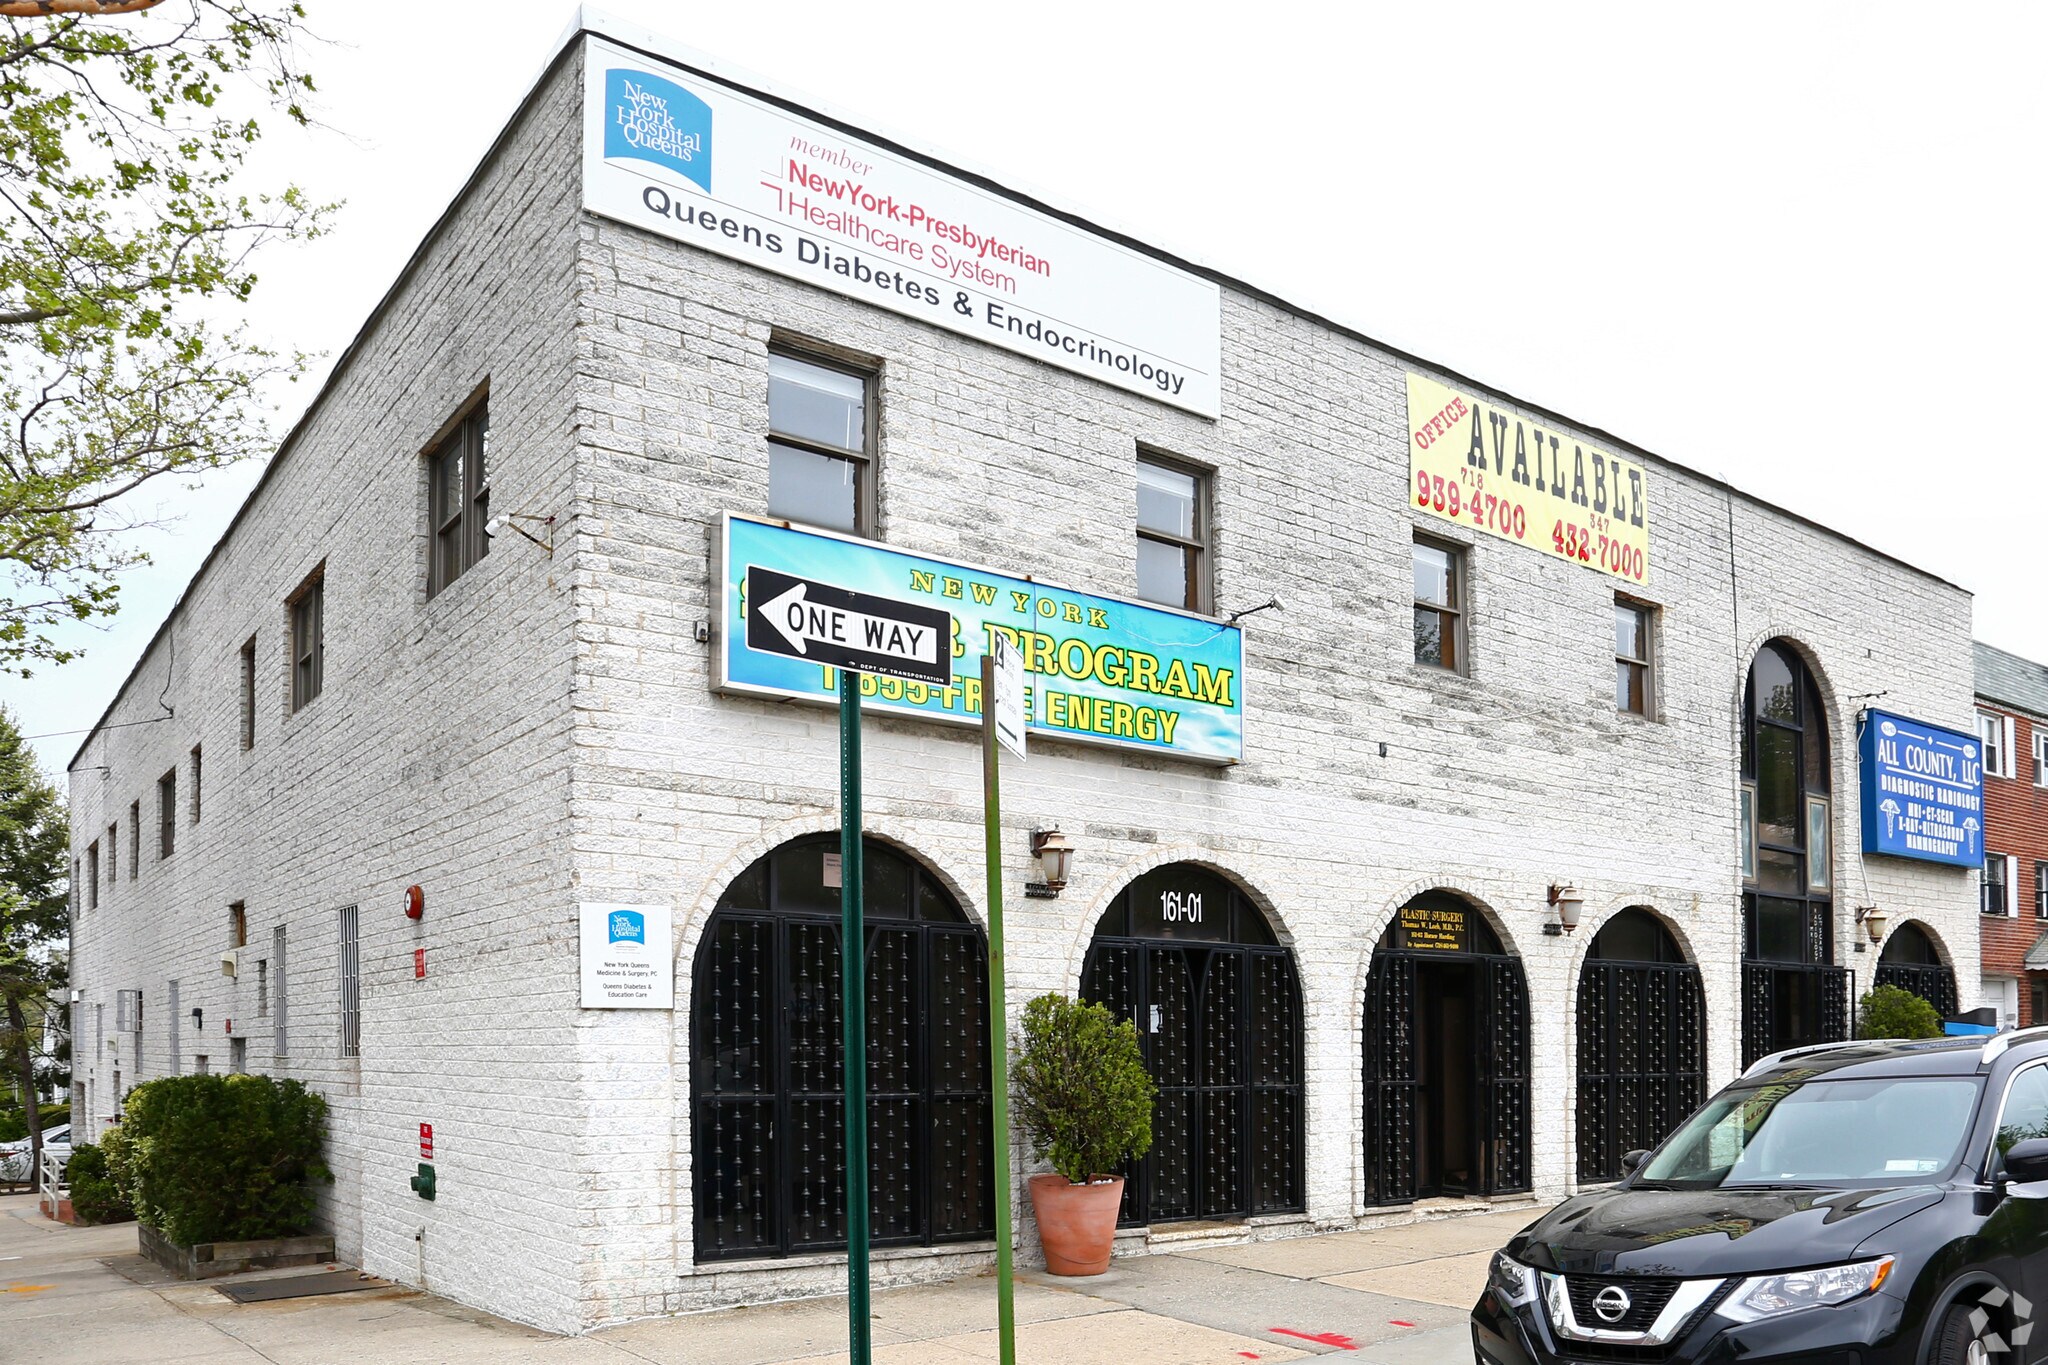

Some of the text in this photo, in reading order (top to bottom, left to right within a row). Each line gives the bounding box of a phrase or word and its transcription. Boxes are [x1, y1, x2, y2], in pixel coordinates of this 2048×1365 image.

[623, 79, 668, 111] New
[631, 97, 676, 129] York
[616, 105, 702, 153] Hospital
[623, 122, 693, 163] Queens
[789, 136, 873, 178] member
[789, 158, 1051, 278] NewYork-Presbyterian
[788, 192, 1017, 295] Healthcare System
[642, 185, 1186, 396] Queens Diabetes & Endocrinology
[1414, 396, 1469, 450] OFFICE
[1467, 402, 1644, 530] AVAILABLE
[1460, 466, 1610, 534] 718 347
[1417, 469, 1644, 581] 939-4700 432-7000
[910, 568, 998, 606] NEW
[1010, 589, 1110, 630] YORK
[786, 601, 847, 643] ONE
[863, 618, 924, 657] WAY
[860, 663, 877, 671] DEPT
[889, 669, 945, 683] TRANSPORTATION
[1045, 689, 1180, 744] ENERGY
[1878, 738, 1981, 787] ALL COUNTY, LLC
[1881, 774, 1981, 812] DIAGNOSTIC RADIOLOGY
[1906, 833, 1958, 857] MAMMOGRAPHY
[1160, 890, 1203, 923] 161-01
[1401, 908, 1465, 923] PLASTIC SURGERY
